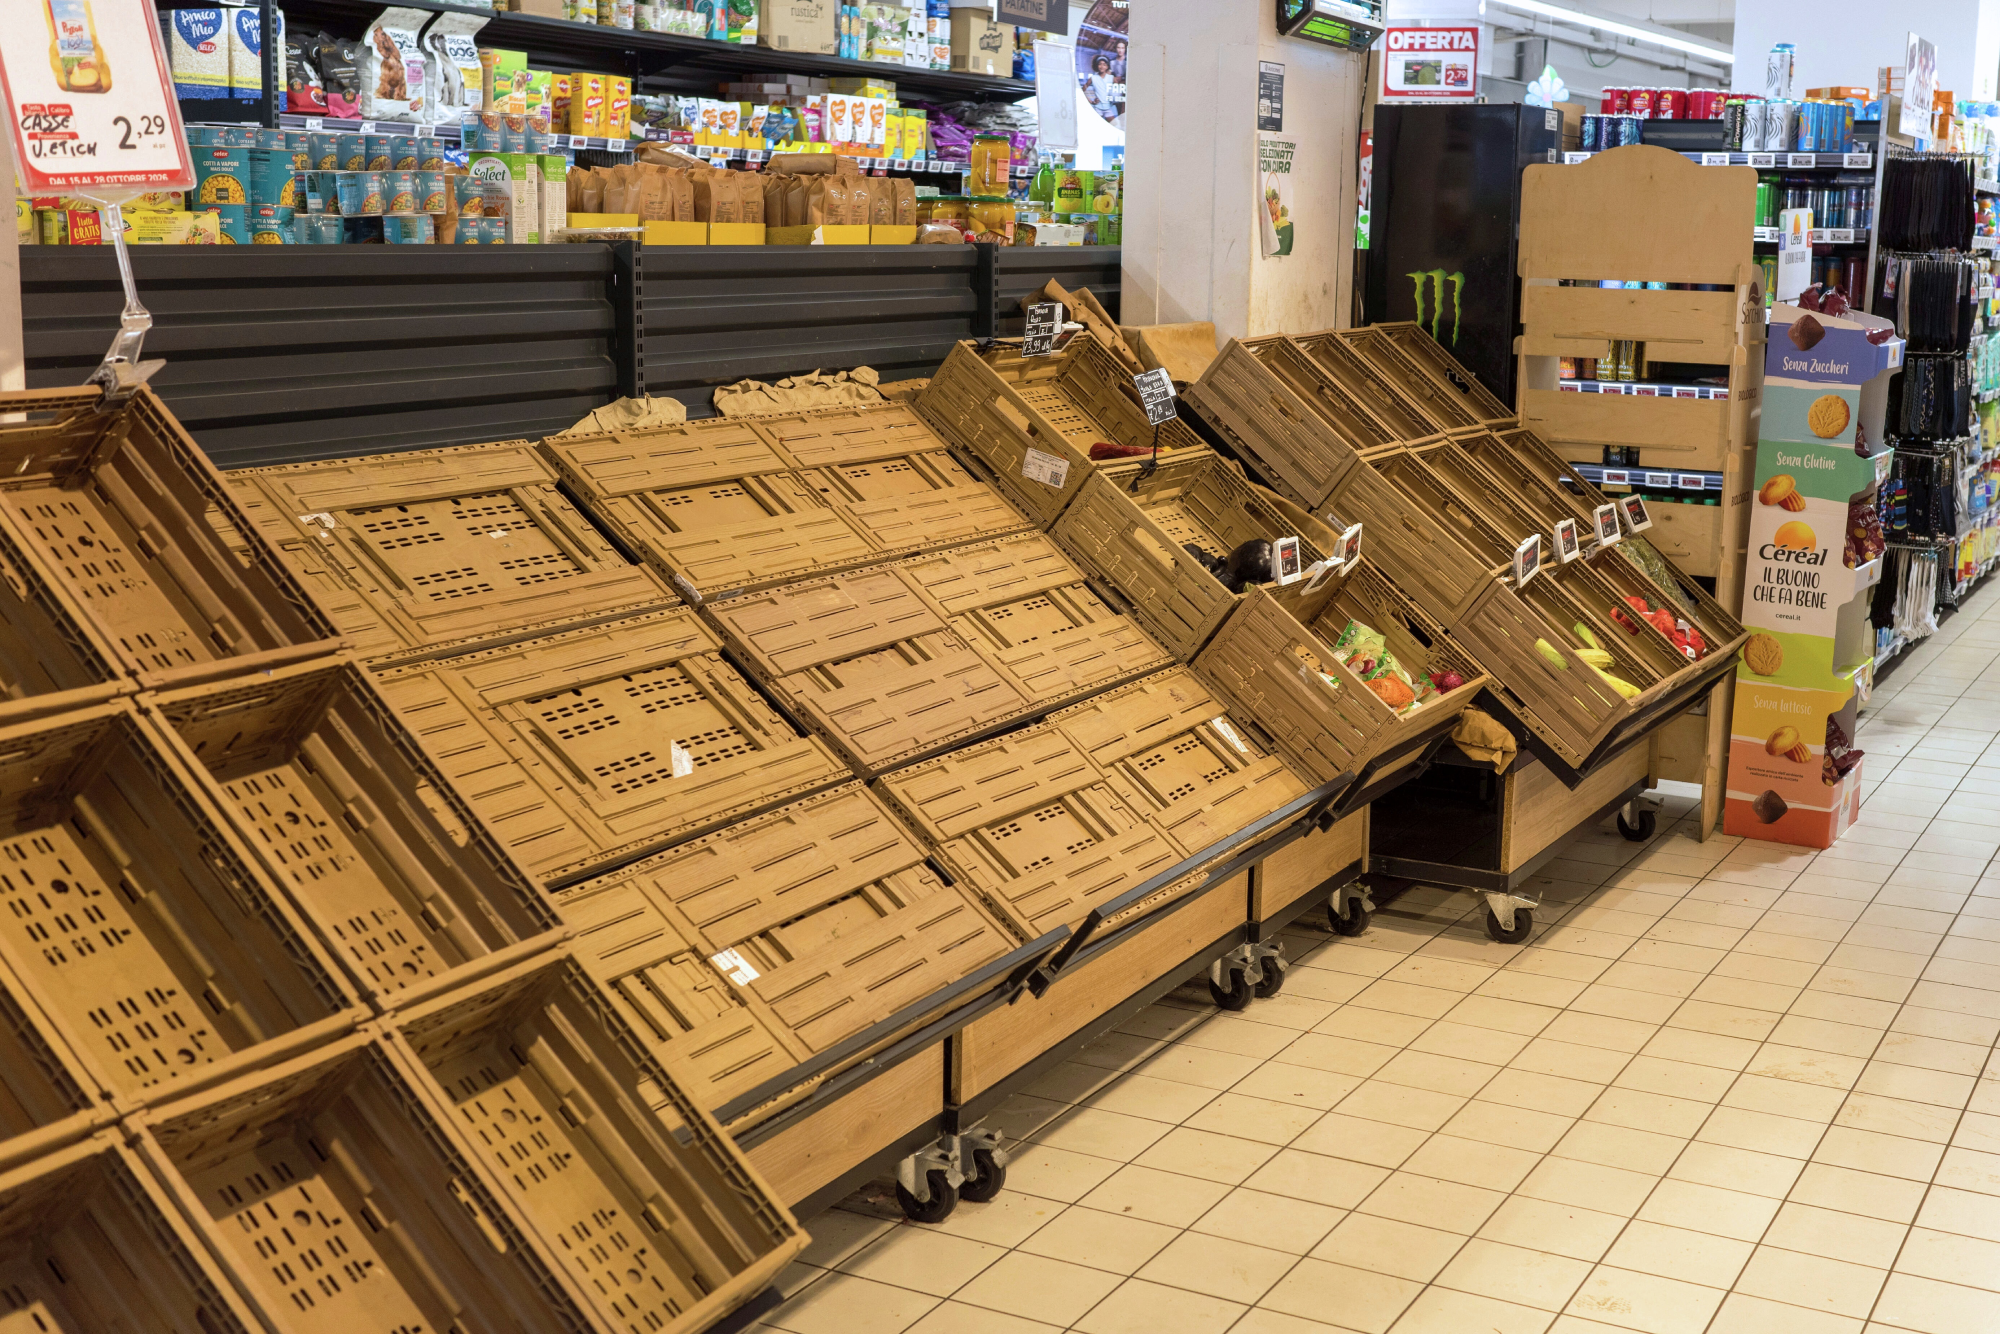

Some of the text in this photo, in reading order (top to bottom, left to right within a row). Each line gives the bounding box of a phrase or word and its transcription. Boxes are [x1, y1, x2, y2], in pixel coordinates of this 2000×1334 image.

[790, 5, 819, 18] rustica
[1005, 0, 1044, 15] PATATINE
[180, 10, 216, 26] Amico
[192, 22, 214, 38] Mio
[199, 43, 216, 52] SELEX
[1388, 30, 1476, 50] OFFERTA
[449, 46, 475, 57] DOG
[1446, 70, 1467, 84] 2,79
[50, 106, 70, 114] Calibro
[20, 113, 71, 133] CASSE
[1733, 105, 1743, 143] Powerking
[112, 115, 165, 150] 2,29
[49, 173, 169, 185] DAL 15 AL 28 OTTOBRE 2026
[474, 166, 506, 181] Select
[73, 224, 100, 239] GRATIS
[1782, 356, 1849, 375] Senza Zuccheri
[1776, 451, 1836, 470] Senza Glutine
[1758, 543, 1828, 567] Céréal
[1763, 566, 1821, 589] IL BUONO
[1753, 584, 1828, 610] CHE FA BENE
[1775, 613, 1801, 621] cereal.it
[1753, 694, 1812, 716] Senza Lattosio
